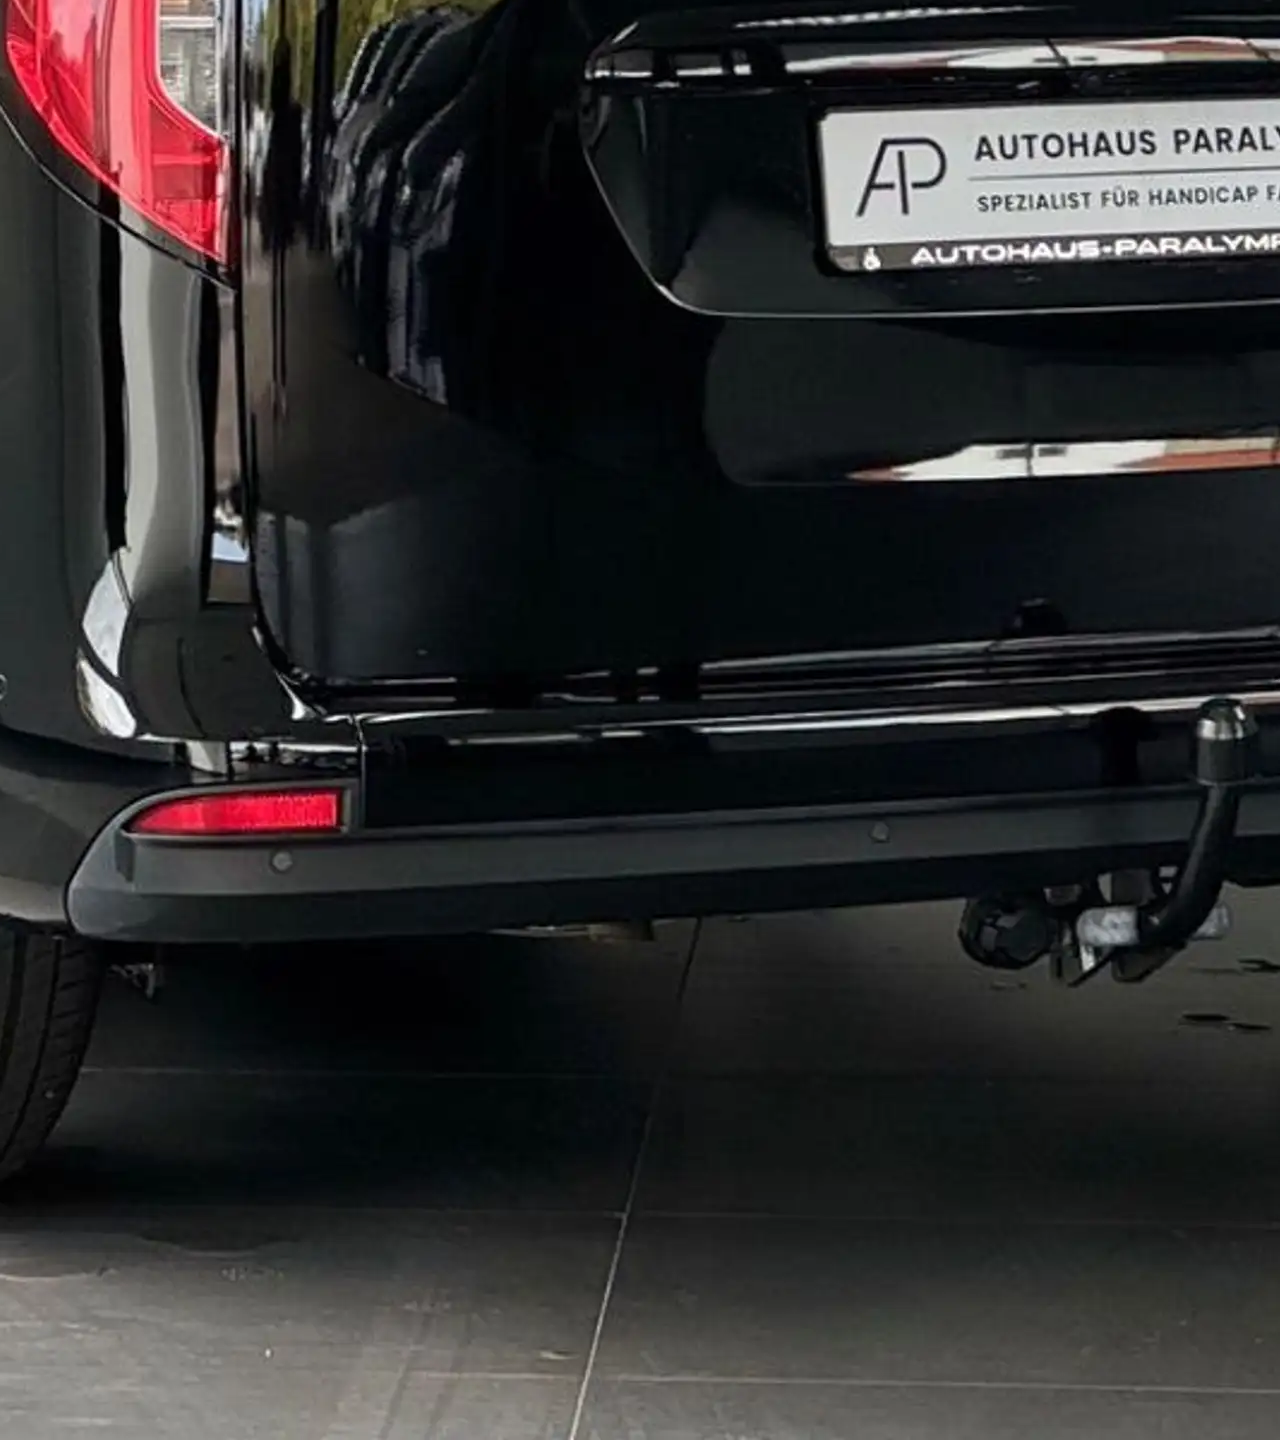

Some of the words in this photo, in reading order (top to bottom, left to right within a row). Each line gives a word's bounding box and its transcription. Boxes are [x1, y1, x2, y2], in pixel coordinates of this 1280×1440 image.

[974, 129, 1157, 162] AUTOHAUS
[976, 191, 1092, 213] SPEZIALIST
[1100, 185, 1140, 210] FÜR
[1148, 184, 1259, 207] HANDICAP
